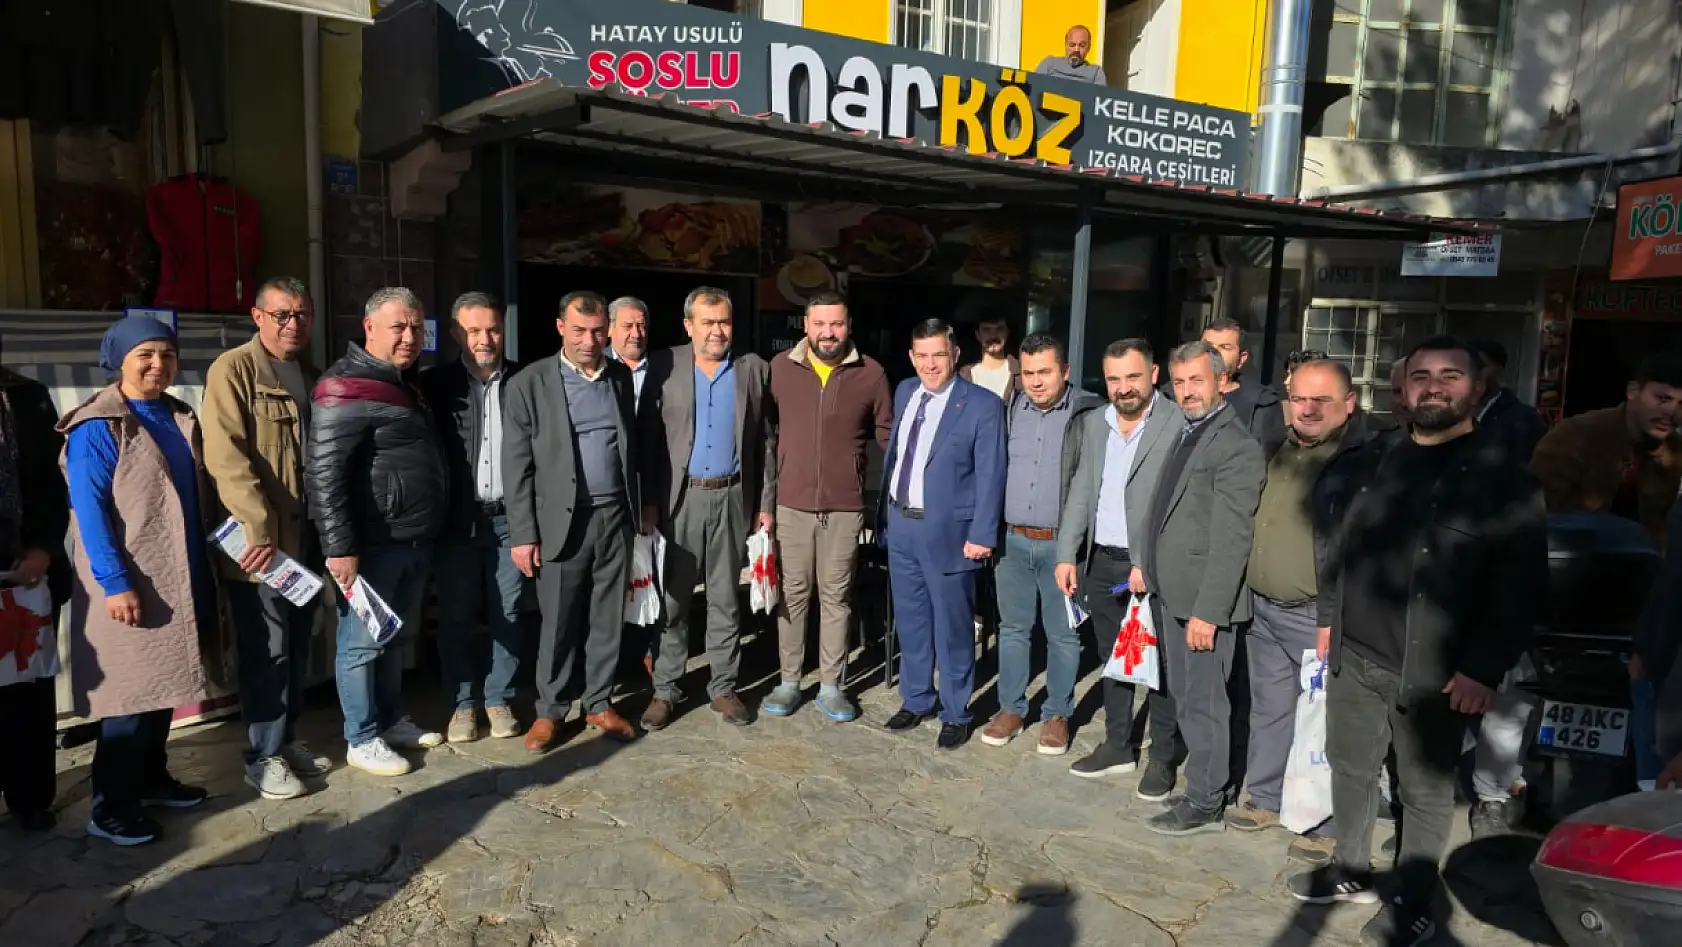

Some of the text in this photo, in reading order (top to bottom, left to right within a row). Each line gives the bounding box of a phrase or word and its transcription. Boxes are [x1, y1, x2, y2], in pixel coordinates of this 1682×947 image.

[590, 21, 743, 43] HATAY USULÜ
[587, 50, 741, 90] SOSLU
[1094, 96, 1170, 128] KELLE
[1088, 149, 1153, 175] IZGARA
[1546, 704, 1626, 730] 48 AKC
[1556, 726, 1601, 749] 426
